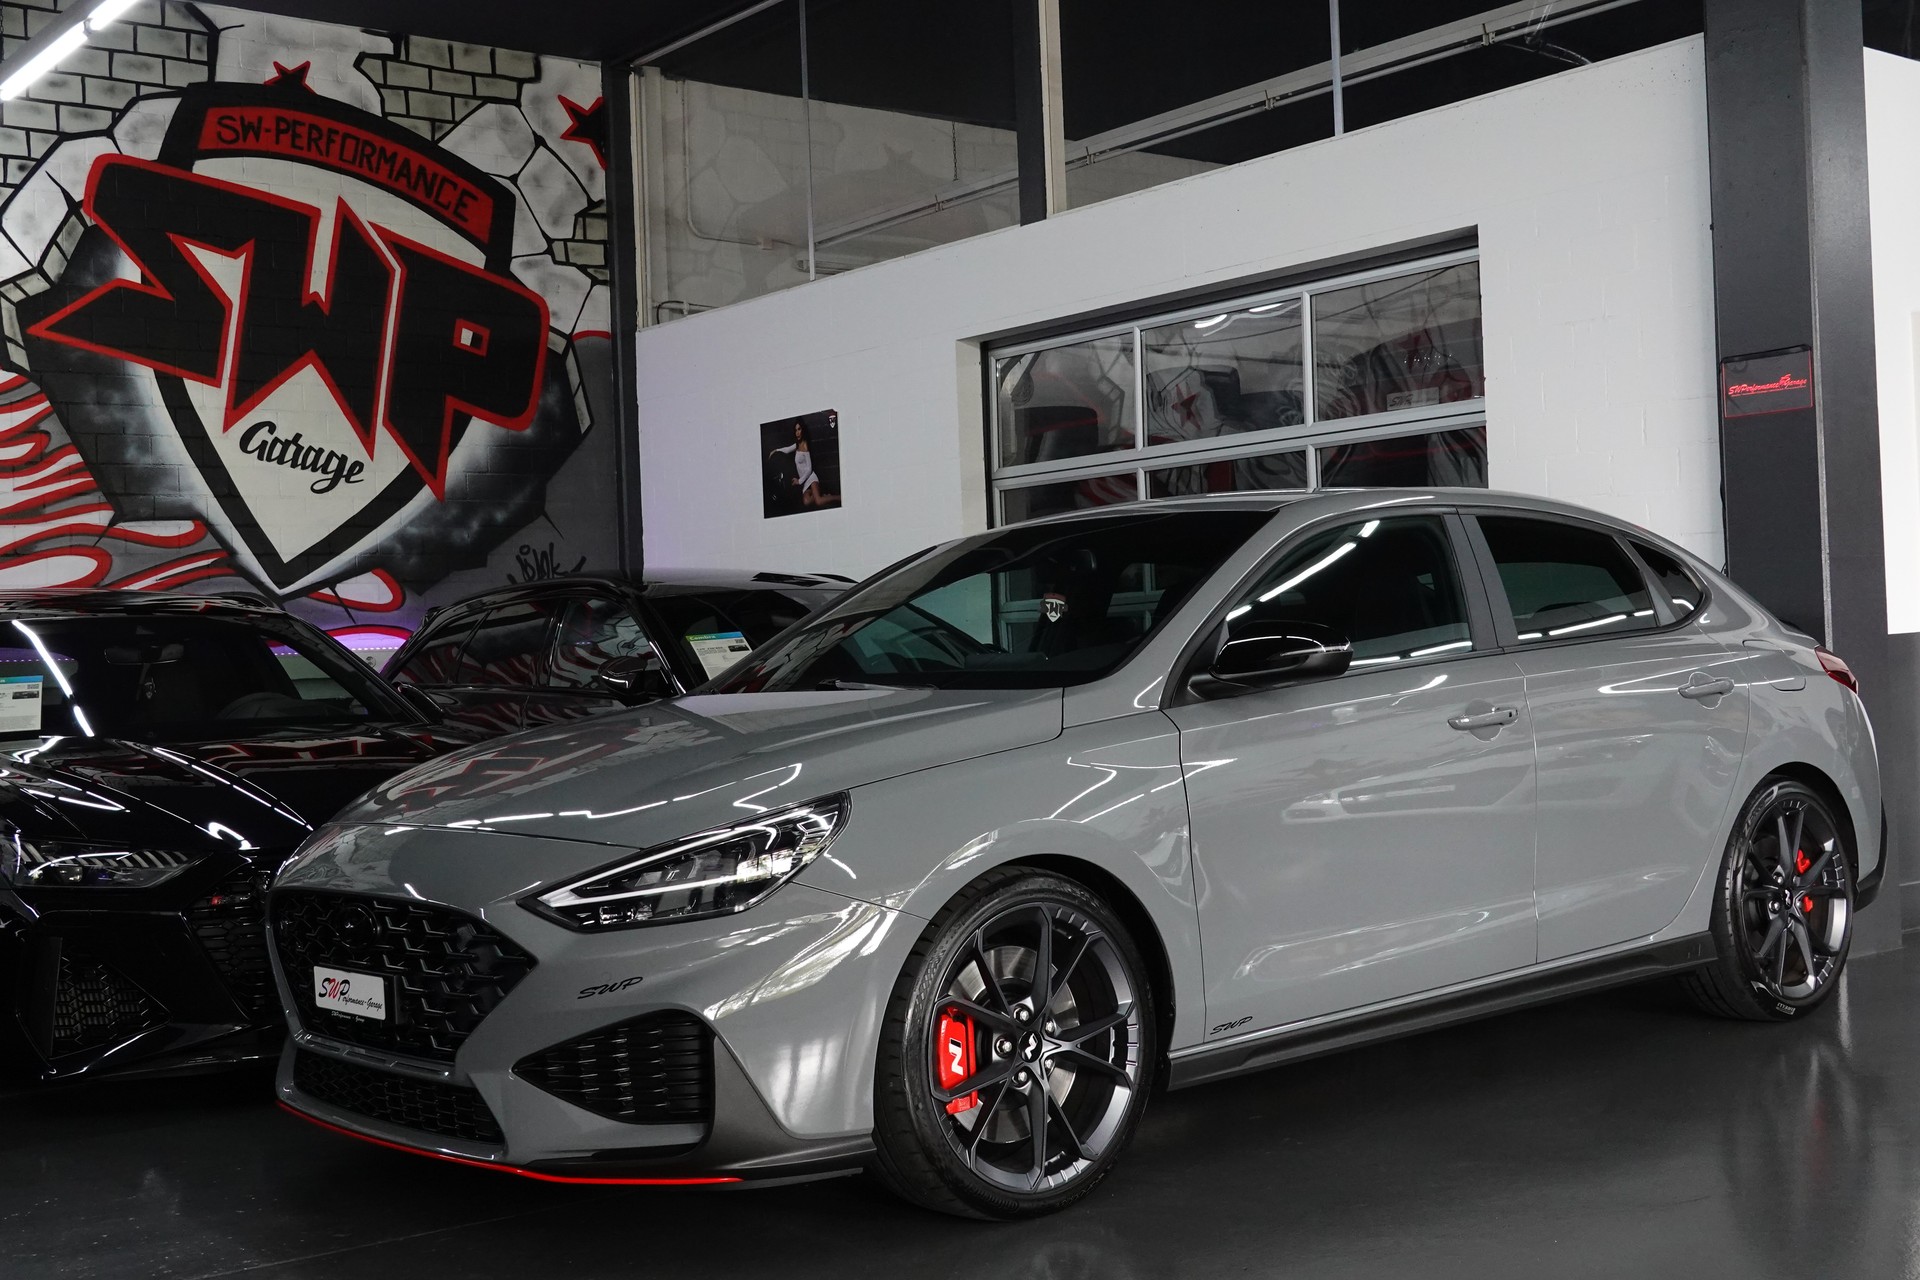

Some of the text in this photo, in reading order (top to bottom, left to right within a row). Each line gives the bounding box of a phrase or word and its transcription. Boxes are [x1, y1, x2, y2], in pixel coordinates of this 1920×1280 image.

[216, 114, 479, 223] SW-PERFORMANCE
[27, 153, 550, 502] SWP
[239, 420, 365, 494] Garage
[577, 976, 643, 999] SWP
[1210, 1015, 1253, 1035] SWP
